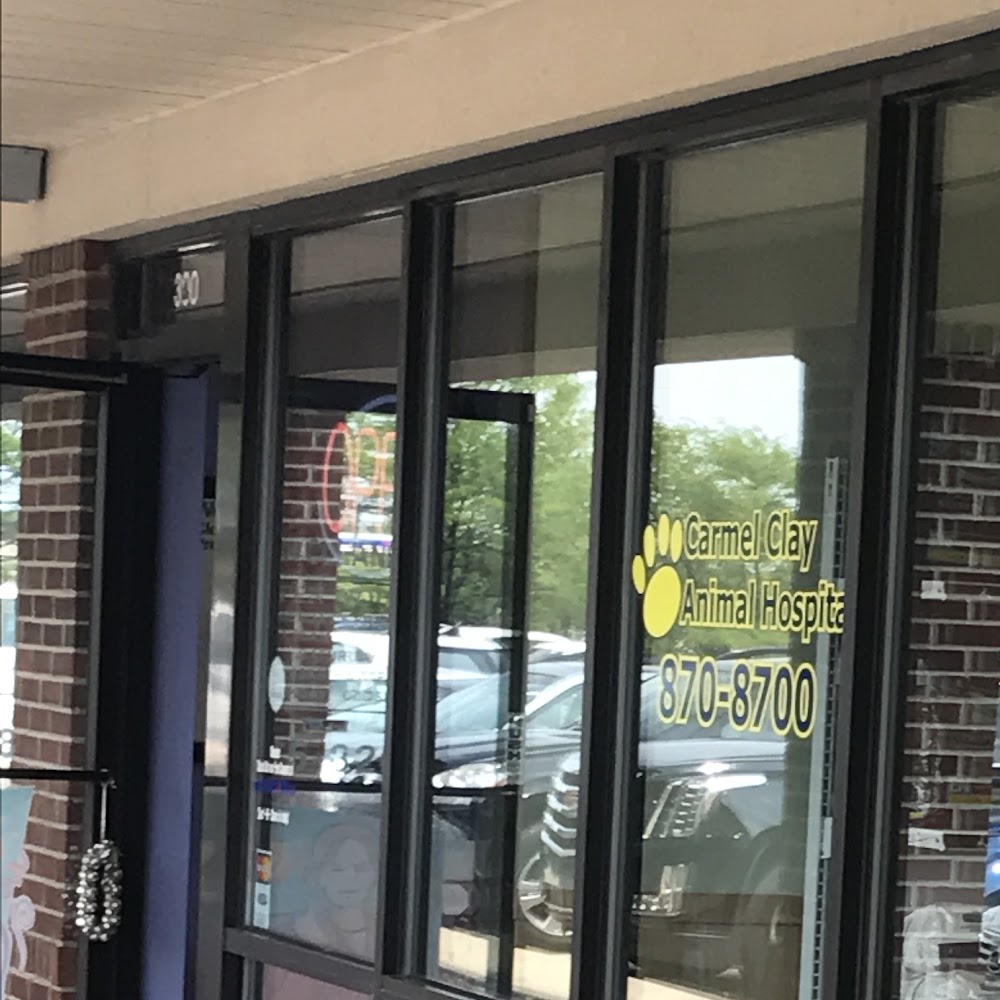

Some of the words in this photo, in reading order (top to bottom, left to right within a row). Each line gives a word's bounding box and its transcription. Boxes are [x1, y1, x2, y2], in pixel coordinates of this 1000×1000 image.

[684, 509, 762, 560] Carmel
[765, 509, 818, 572] Clay
[678, 578, 757, 630] Animal
[657, 653, 818, 738] 870-8700
